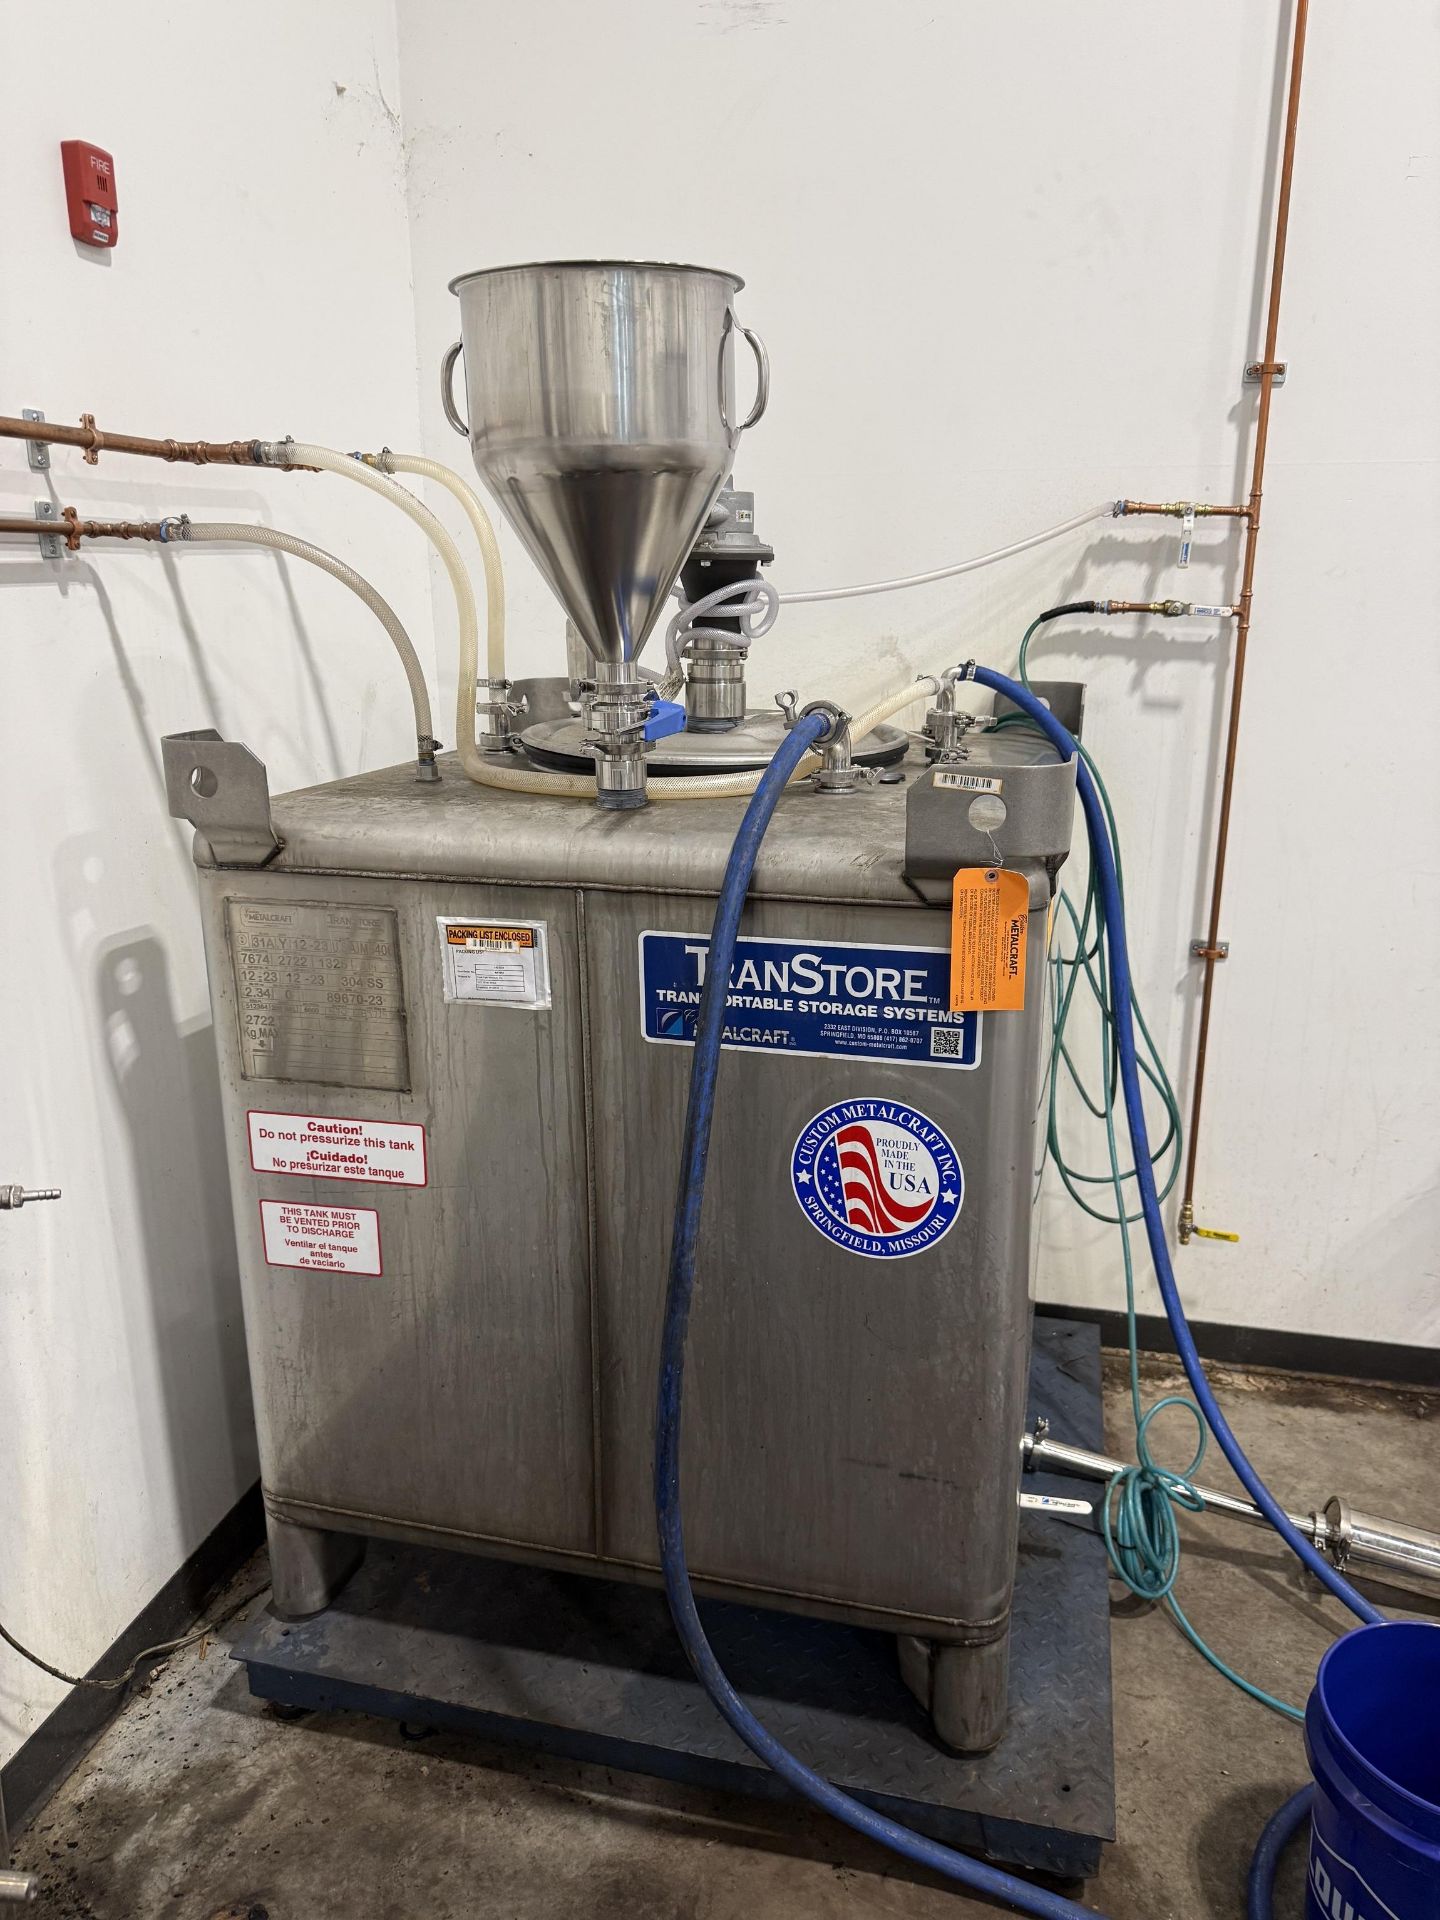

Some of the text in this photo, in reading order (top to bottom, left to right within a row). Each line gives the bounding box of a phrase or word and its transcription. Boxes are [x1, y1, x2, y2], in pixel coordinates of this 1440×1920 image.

[90, 156, 111, 175] FIRE
[328, 914, 381, 927] TRANTORE
[448, 929, 530, 942] PACKING LIST ENCLOSED
[1009, 919, 1020, 976] METALCRAFT
[241, 953, 270, 964] 7674
[278, 956, 308, 967] 2722
[685, 945, 928, 1003] TANSTORE
[341, 976, 363, 987] 304
[367, 979, 384, 988] SS
[244, 987, 271, 998] 2.34
[656, 989, 965, 1024] TRANRTABLE STORAGE SYSTEMS
[245, 1015, 275, 1026] 2722
[692, 1025, 790, 1045] ALCRAFT
[306, 1121, 363, 1135] Caution!
[259, 1128, 415, 1151] Do not pressurize this tank
[798, 1103, 957, 1185] CUSTOM METALCRAFT INC.
[875, 1137, 921, 1152] PROUDLY
[306, 1150, 368, 1165] ¡Cuidado!
[881, 1149, 909, 1160] MADE
[272, 1157, 405, 1180] No presurizar este tanque
[884, 1159, 916, 1171] IN THE
[889, 1172, 932, 1194] USA
[281, 1207, 357, 1221] THIS TANK MUST
[279, 1215, 361, 1231] BE VENTED PRIOR
[804, 1196, 948, 1254] SPRINGFIELD, MISSOURI
[286, 1225, 355, 1239] TO DISCHARGE
[284, 1238, 358, 1254] Ventilar el tanque
[310, 1250, 333, 1259] antes
[299, 1256, 346, 1269] de vaciarlo
